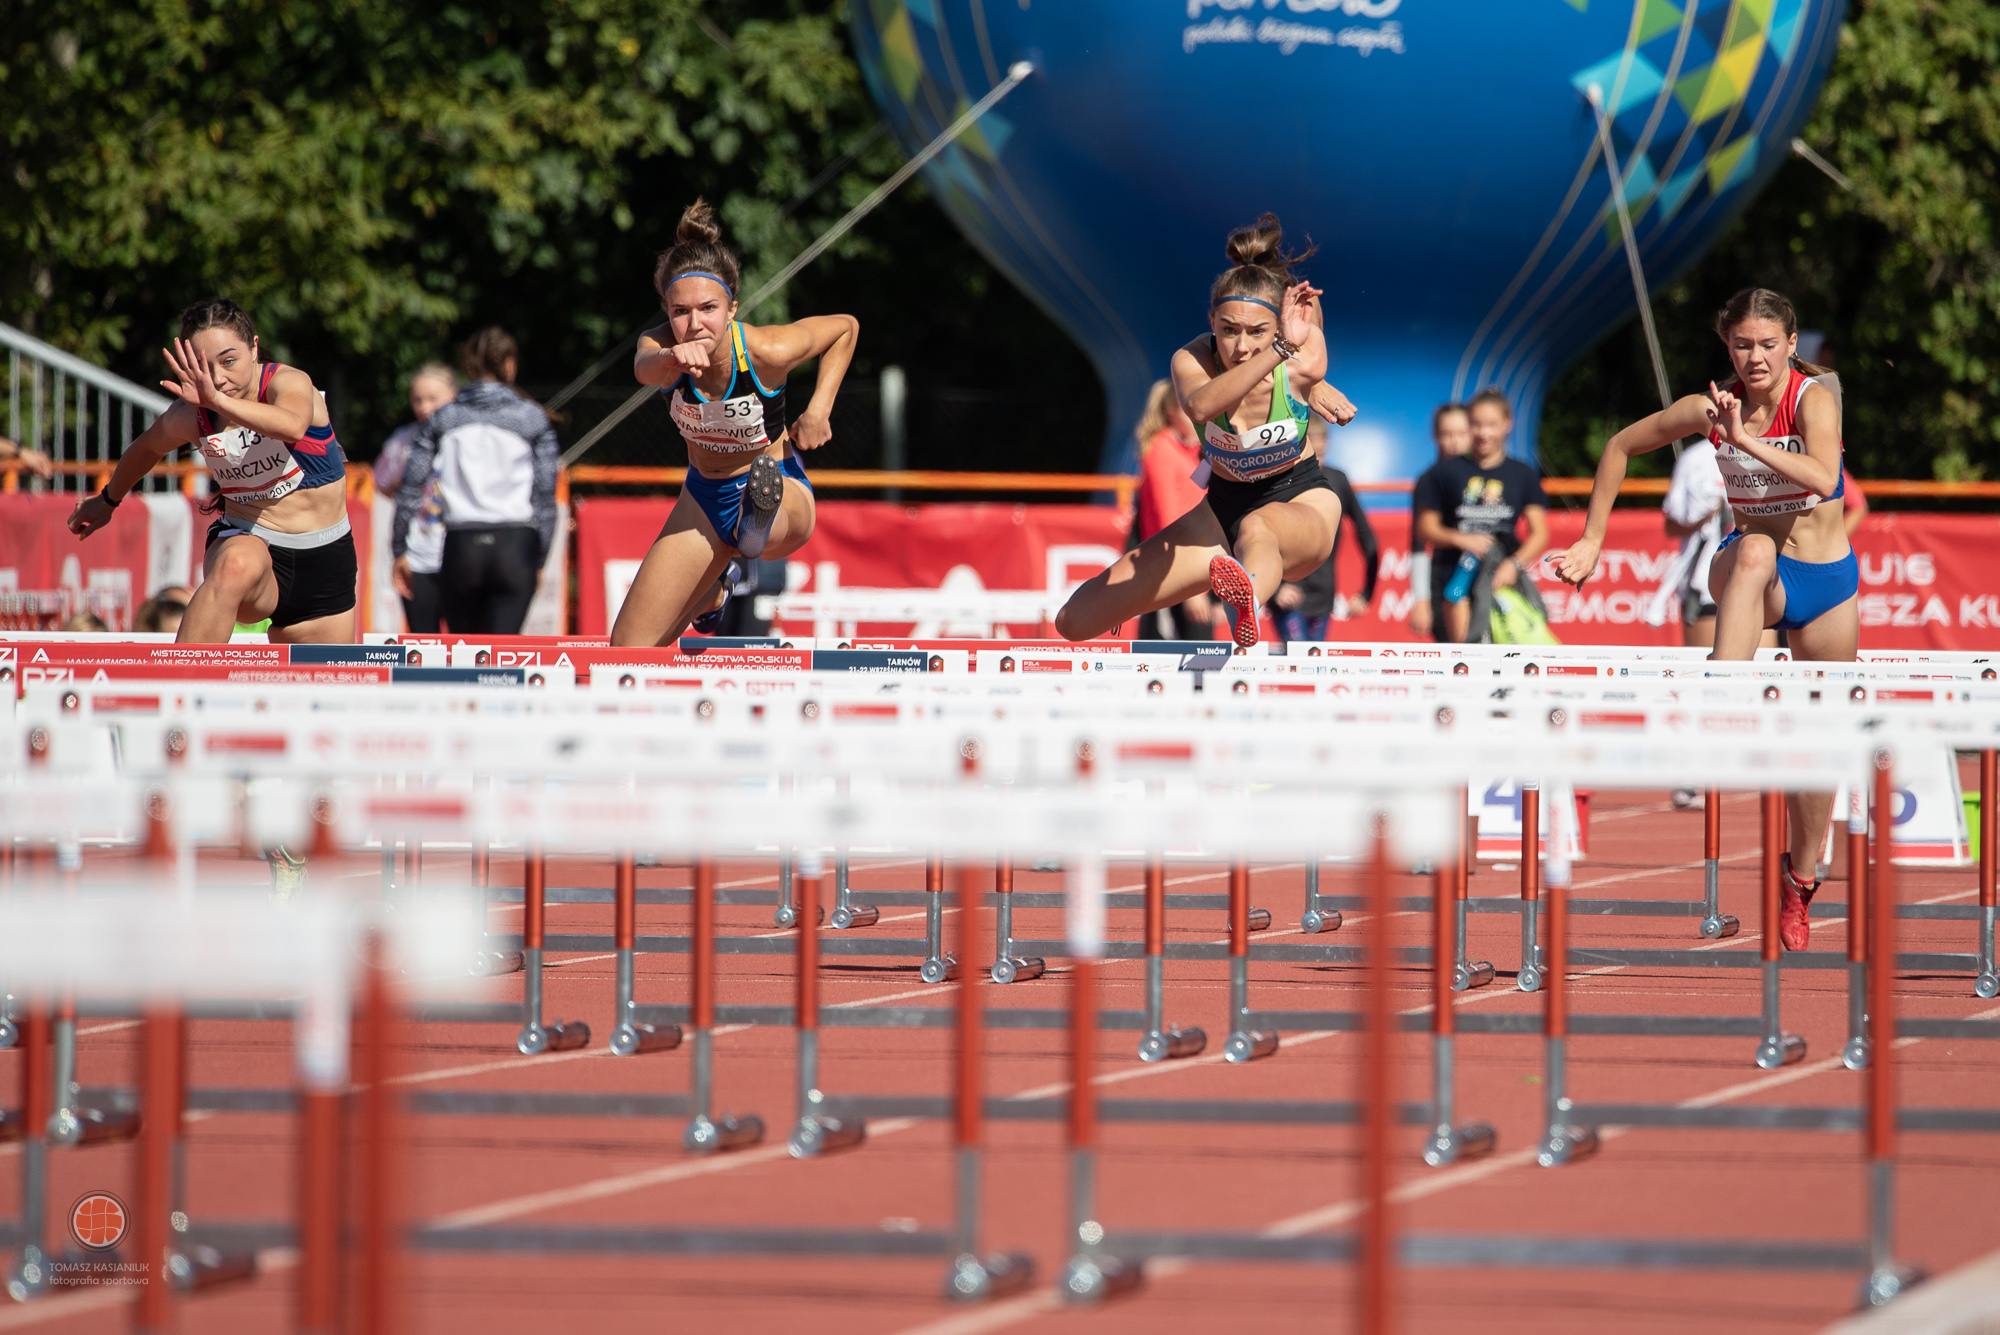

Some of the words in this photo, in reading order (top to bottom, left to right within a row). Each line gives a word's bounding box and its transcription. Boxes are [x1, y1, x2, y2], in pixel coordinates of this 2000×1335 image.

[724, 400, 752, 418] 53
[238, 429, 274, 450] 13
[1260, 425, 1288, 446] 92
[1210, 436, 1239, 451] ORLEN
[214, 453, 286, 481] MARCZUK
[270, 482, 292, 498] 2019
[1742, 504, 1782, 515] TARNÓW
[1784, 501, 1807, 511] 2019
[1860, 551, 1937, 586] U16
[150, 649, 223, 658] MISTRZOSTWA
[225, 650, 261, 659] POLSKI
[262, 651, 279, 659] U16
[365, 651, 399, 660] TARNÓW
[1196, 646, 1227, 655] TARNÓW
[673, 654, 745, 663] MISTRZOSTWA
[747, 656, 783, 664] POLSKI
[785, 656, 802, 664] U16
[887, 656, 921, 666] TARNÓW
[227, 671, 311, 683] MISTRZOSTWA
[312, 671, 358, 684] POLSKI
